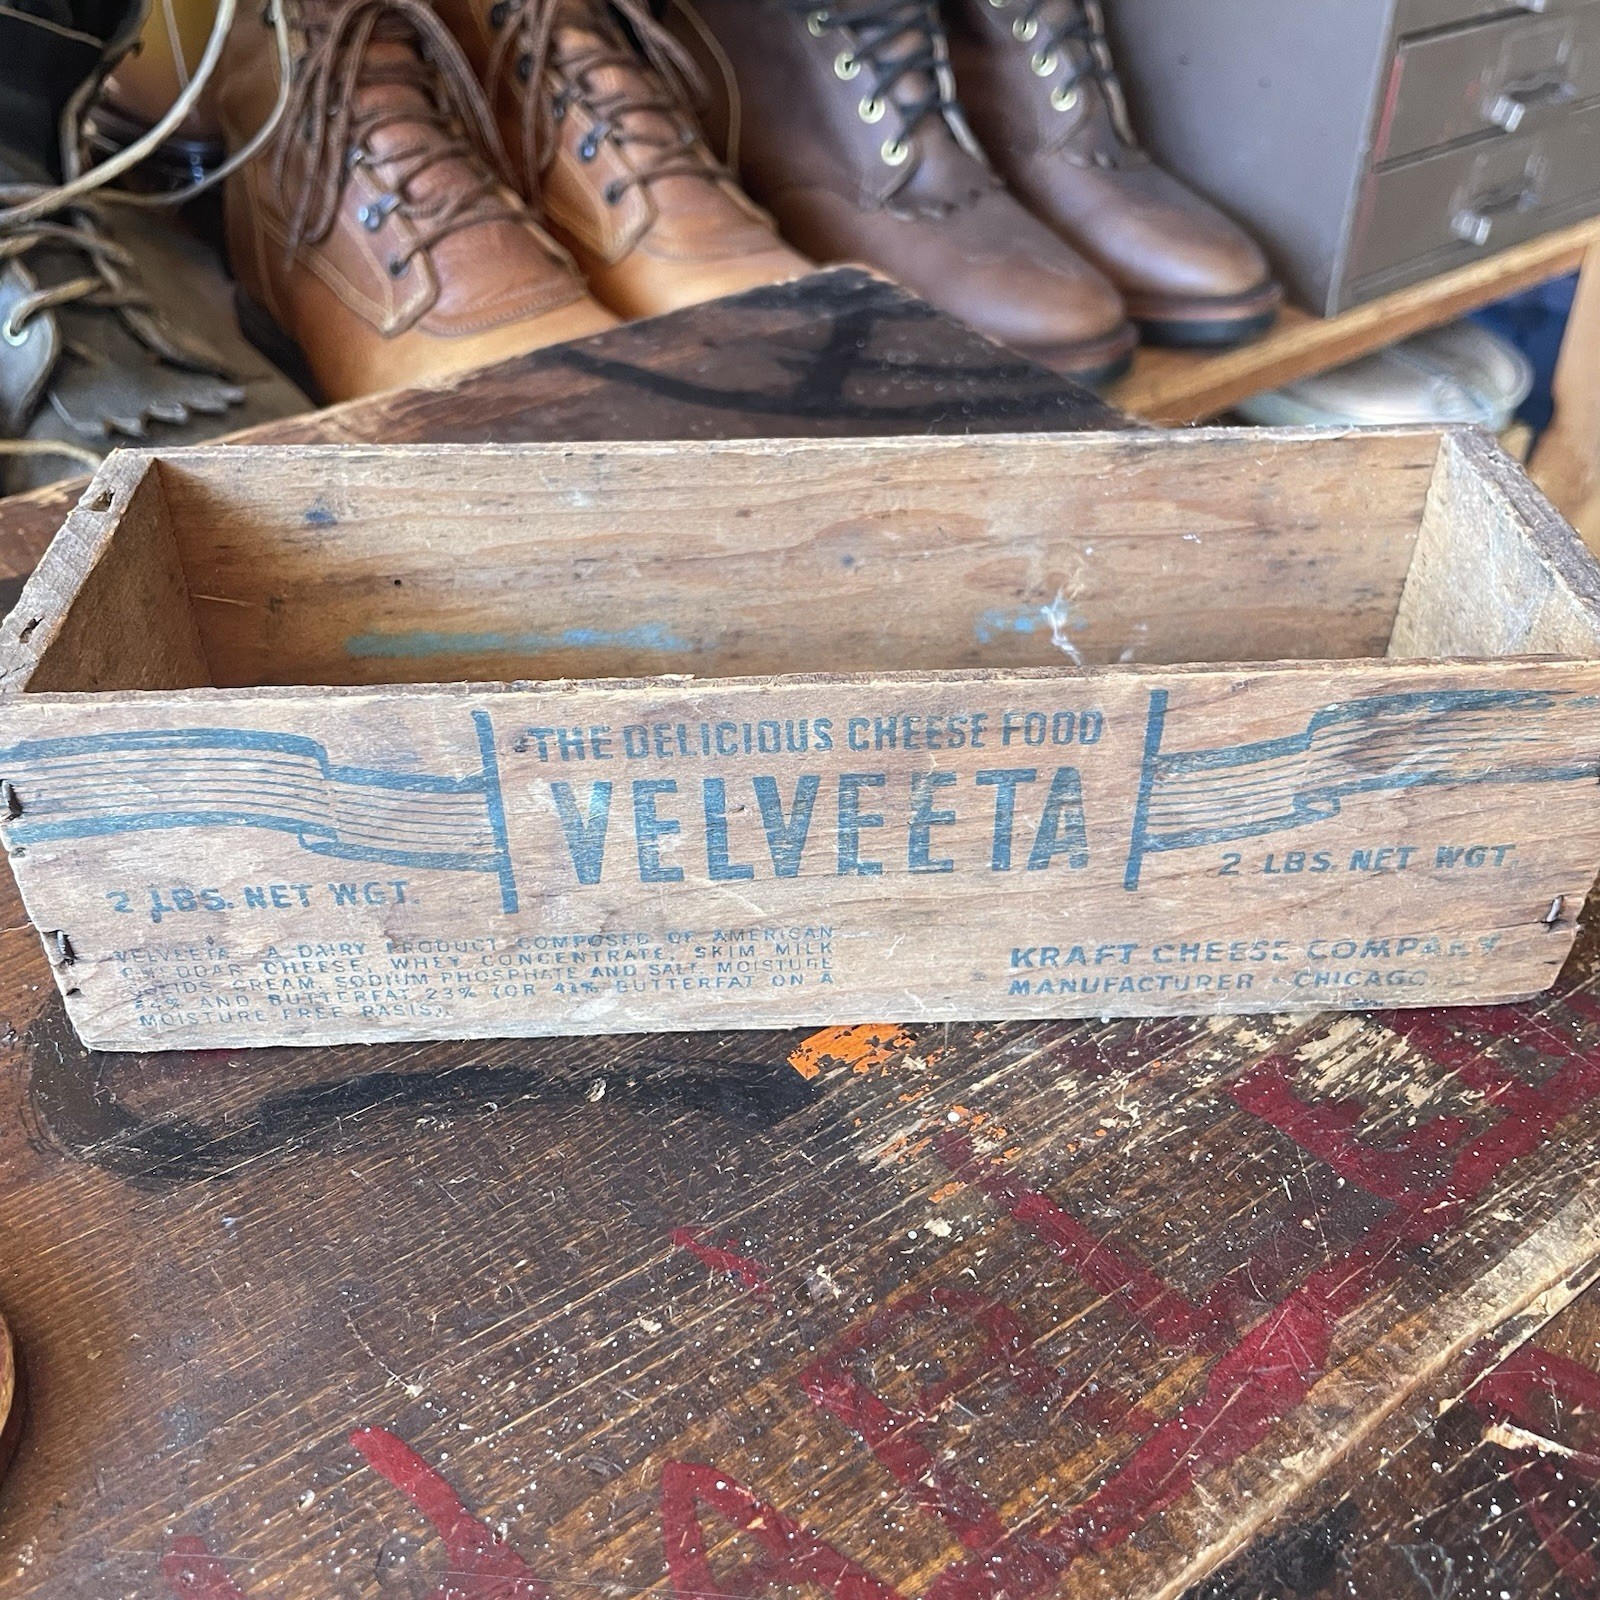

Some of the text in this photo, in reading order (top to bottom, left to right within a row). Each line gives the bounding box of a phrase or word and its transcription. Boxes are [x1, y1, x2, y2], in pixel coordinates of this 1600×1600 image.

[526, 710, 1103, 762] THE DELICIOUS CHEESE FOOD
[551, 766, 1090, 885] VELVEETA
[1218, 852, 1242, 876] 2
[1350, 846, 1418, 872] NET
[105, 890, 134, 913] 2
[244, 883, 313, 910] NET
[266, 945, 280, 959] A
[297, 941, 367, 959] DAIRY
[386, 937, 496, 955] PRODUCT
[518, 929, 649, 950] COMPOSED
[668, 929, 695, 944] OF
[713, 926, 834, 943] AMERICAN
[390, 955, 460, 970] WHEY
[695, 945, 756, 960] SKIM
[775, 942, 834, 957] MILK
[1010, 942, 1138, 968] KRAFT
[1152, 938, 1290, 964] CHEESE
[335, 972, 429, 989] SODIUM
[441, 966, 577, 984] PHOSPHATE
[591, 963, 637, 978] AND
[717, 957, 834, 974] MOISTURE
[1008, 972, 1254, 997] MANUFACTURER
[200, 995, 250, 1008] AND
[268, 987, 410, 1007] BUTTERFAT
[425, 986, 477, 1000] 23%
[616, 974, 755, 993] BUTTERFAT
[772, 973, 805, 987] ON
[820, 972, 834, 985] A
[138, 1009, 269, 1028] MOISTURE
[283, 1005, 344, 1021] FREE
